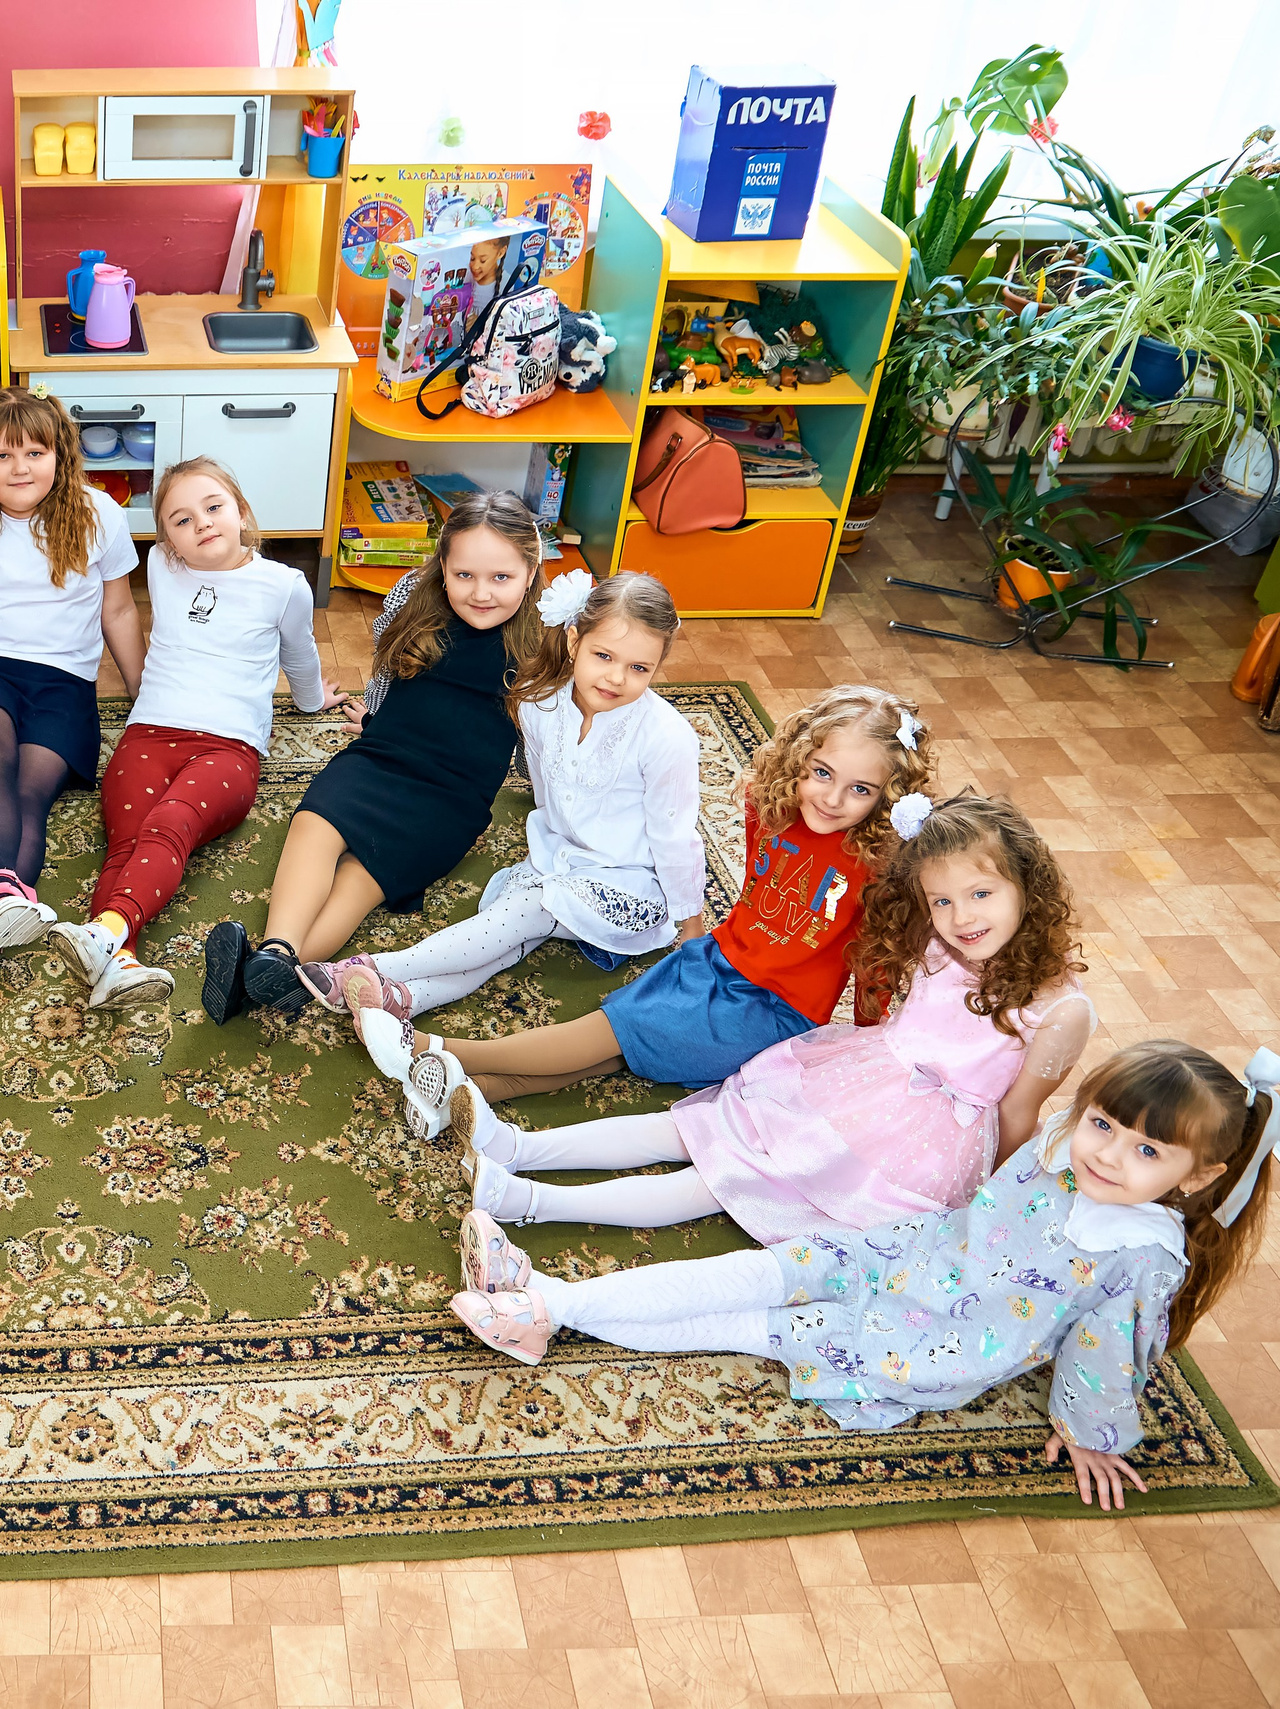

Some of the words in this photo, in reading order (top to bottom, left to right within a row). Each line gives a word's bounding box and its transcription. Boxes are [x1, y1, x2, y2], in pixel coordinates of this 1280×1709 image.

[726, 95, 827, 126] ПОЧТА
[747, 162, 781, 174] ПОЧТА
[745, 175, 780, 186] РОССИИ
[367, 484, 382, 500] ЛЕТО
[546, 491, 560, 499] 40
[376, 505, 391, 522] ЗИМА
[754, 835, 849, 921] STAR
